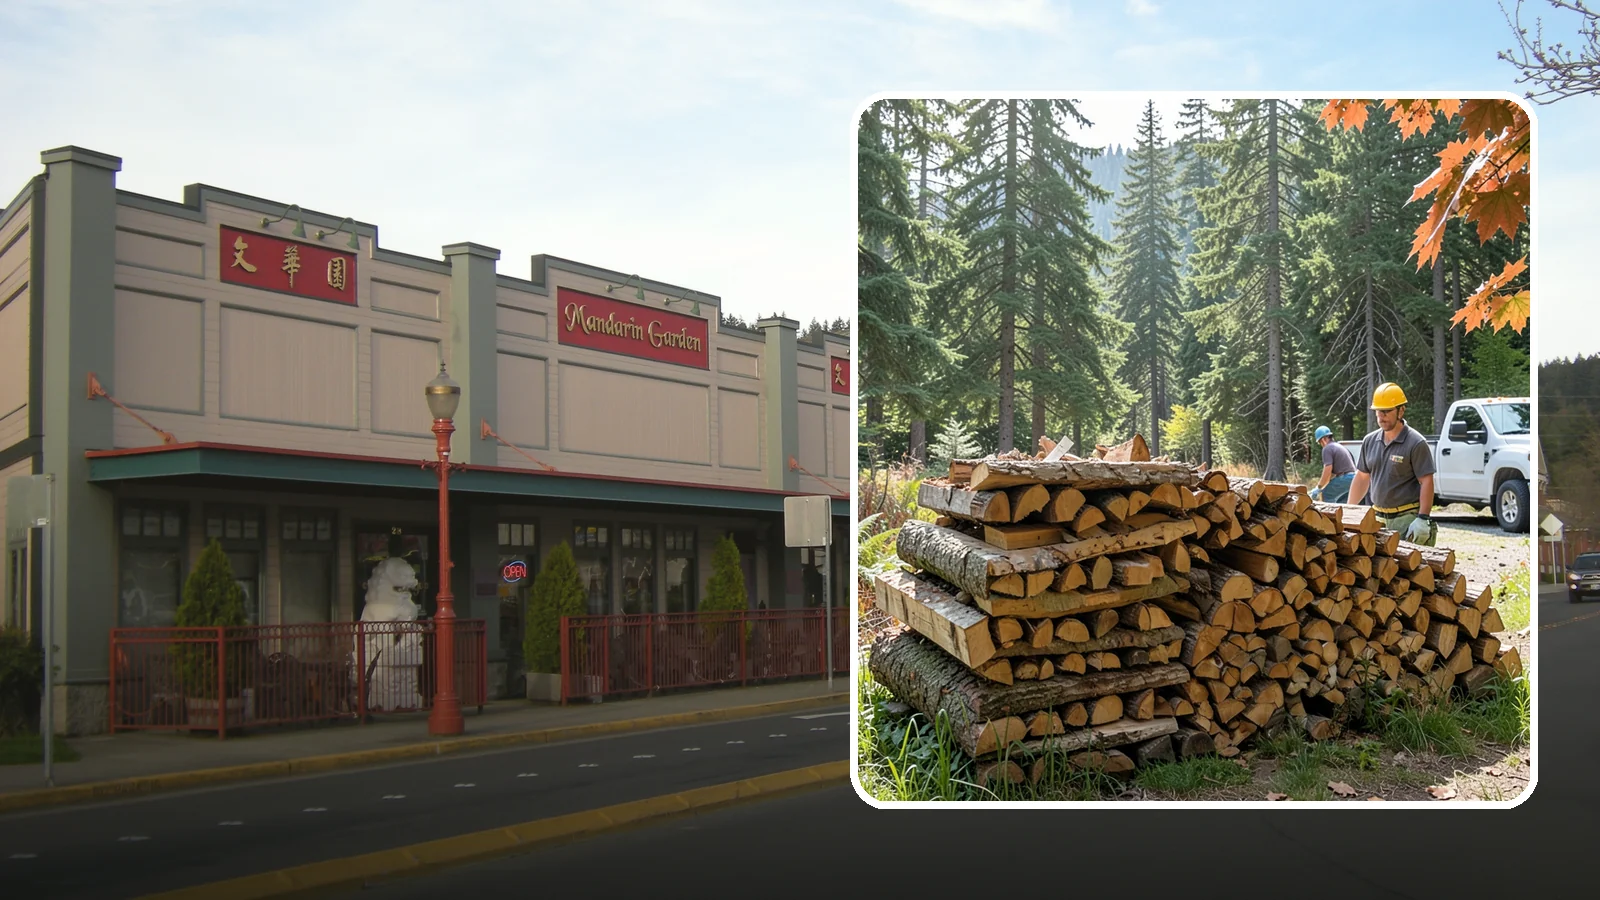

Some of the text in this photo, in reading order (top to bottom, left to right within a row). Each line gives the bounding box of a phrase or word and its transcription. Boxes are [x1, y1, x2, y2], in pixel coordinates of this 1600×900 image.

[230, 235, 346, 291] 文華園
[564, 302, 701, 352] Mandarin Garden
[834, 363, 846, 386] 文
[503, 565, 527, 578] OPEN
